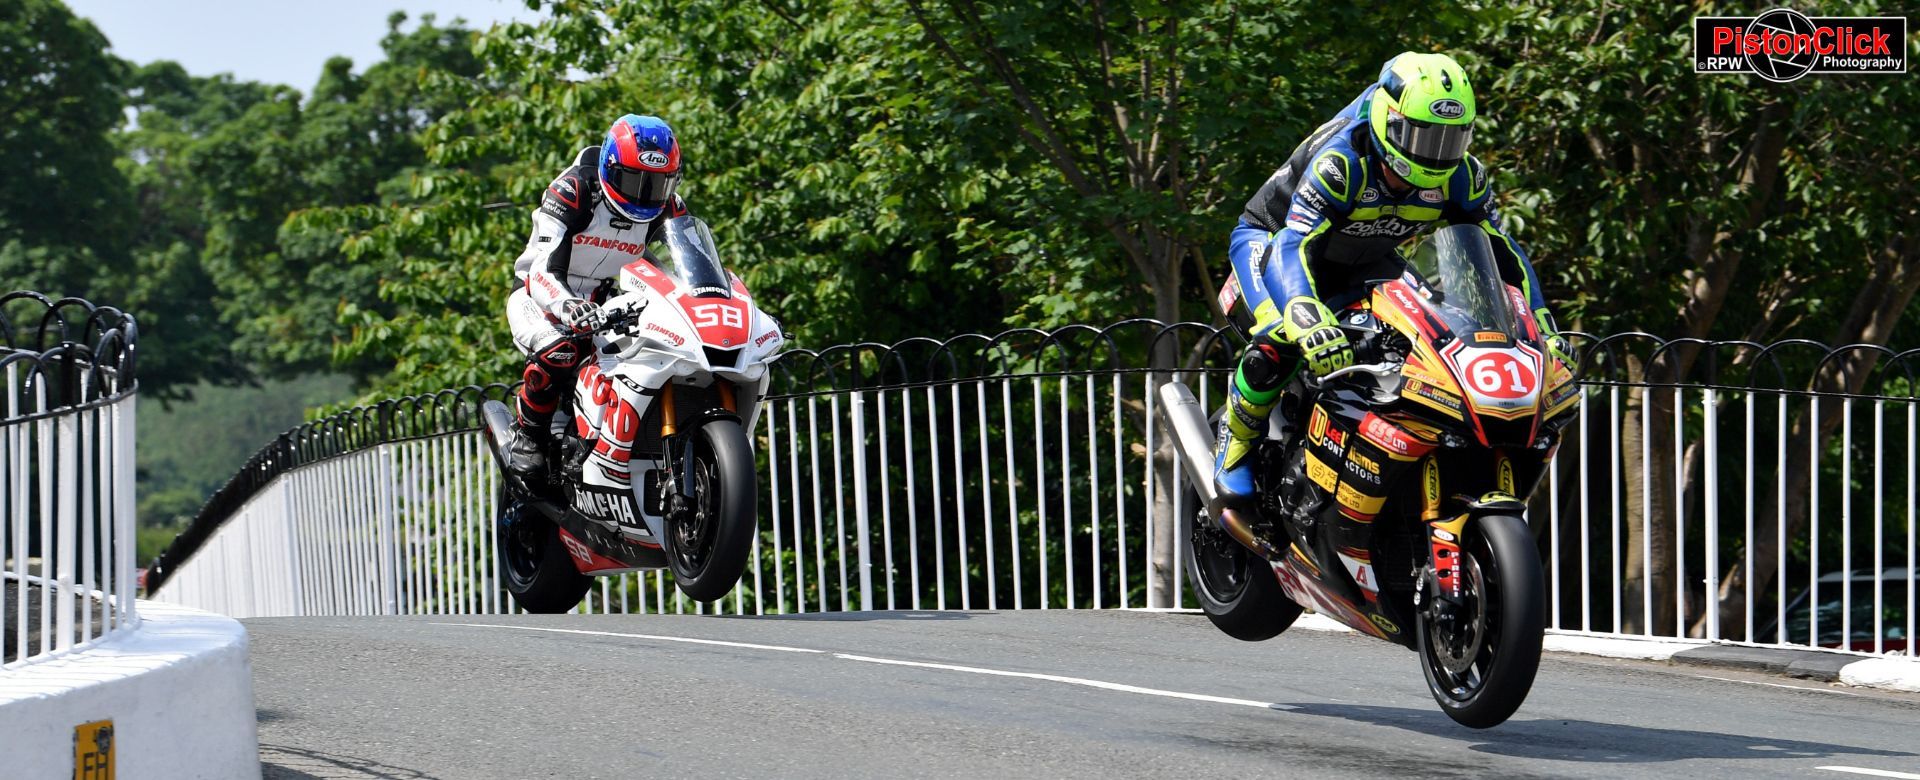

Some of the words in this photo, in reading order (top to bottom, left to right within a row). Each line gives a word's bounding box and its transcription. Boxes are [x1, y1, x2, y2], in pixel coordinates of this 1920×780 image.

[1432, 101, 1461, 114] Arai
[640, 153, 665, 163] Arai
[573, 234, 644, 256] STANFORD
[691, 286, 730, 297] STANFORD
[691, 303, 743, 329] 58
[645, 322, 685, 346] STANFORD
[755, 330, 780, 347] STANFORD
[1472, 359, 1528, 393] 61
[579, 365, 639, 443] FORD
[1392, 437, 1408, 450] LTD
[562, 534, 593, 565] 58
[1450, 551, 1460, 598] PIRELLI
